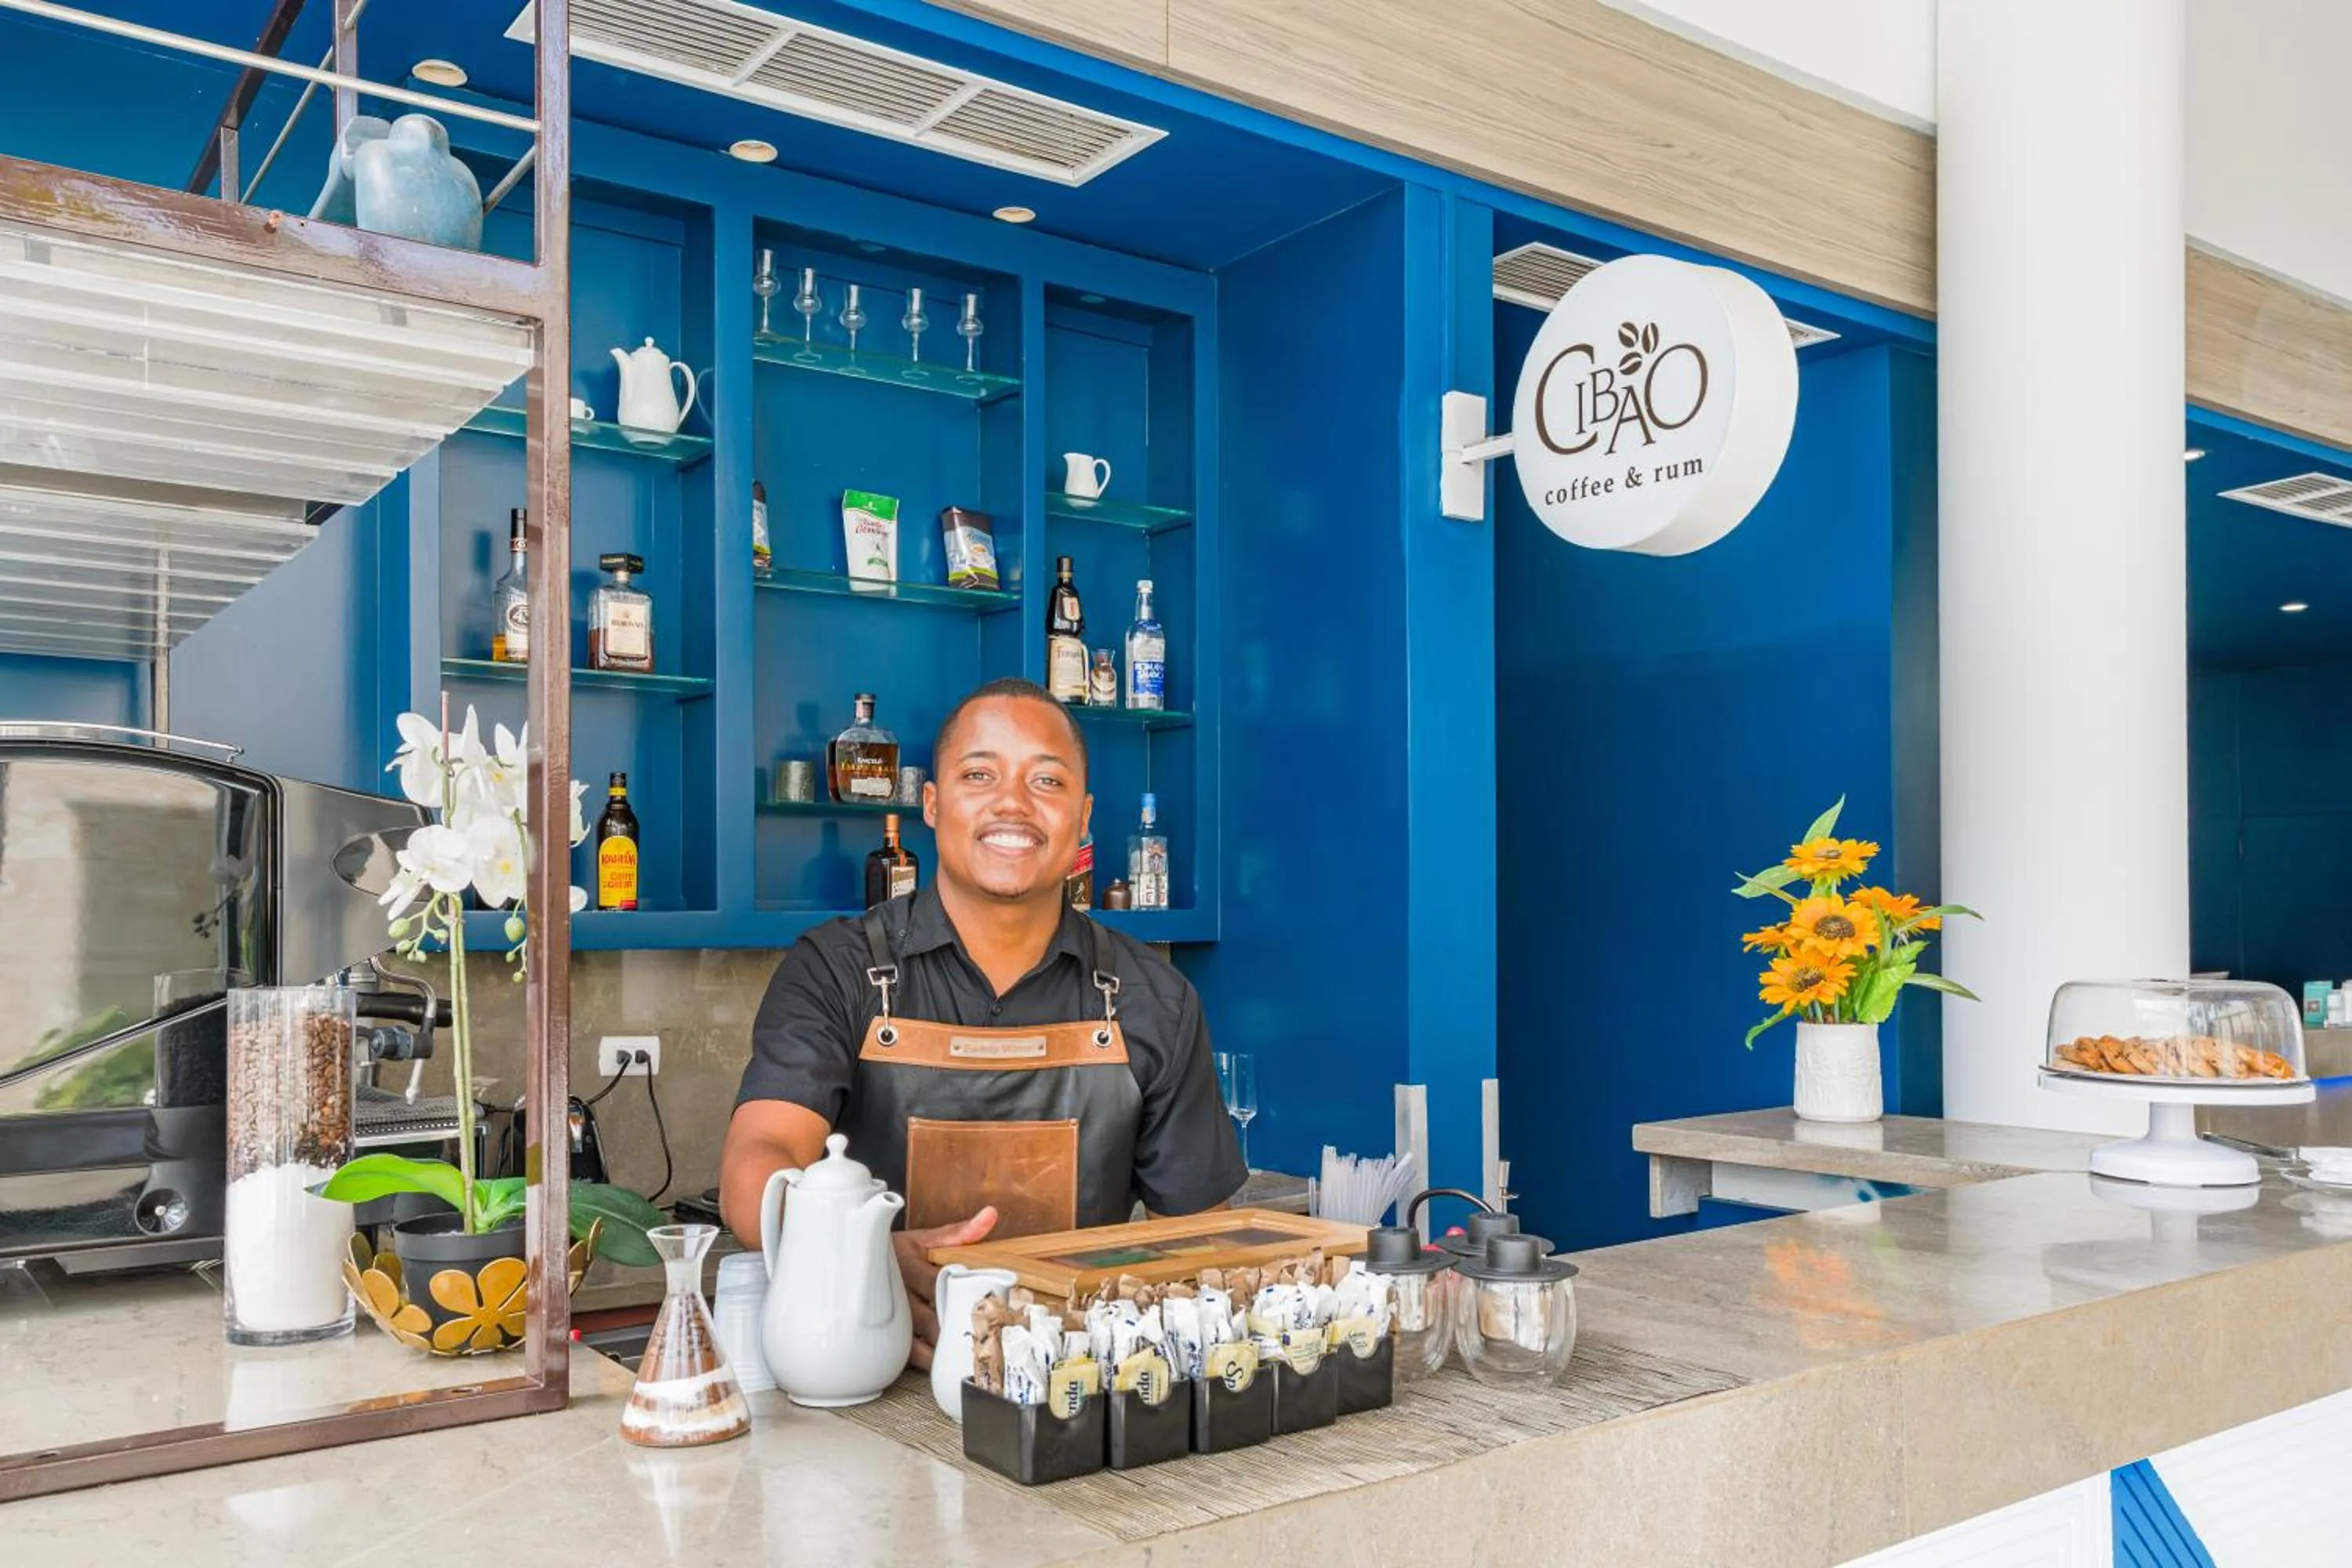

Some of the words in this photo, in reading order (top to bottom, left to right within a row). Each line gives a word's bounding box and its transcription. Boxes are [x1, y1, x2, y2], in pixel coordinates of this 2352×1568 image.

[1534, 343, 1708, 456] CIBAO
[1545, 476, 1614, 506] coffee
[1624, 466, 1643, 488] &
[1654, 457, 1704, 482] rum
